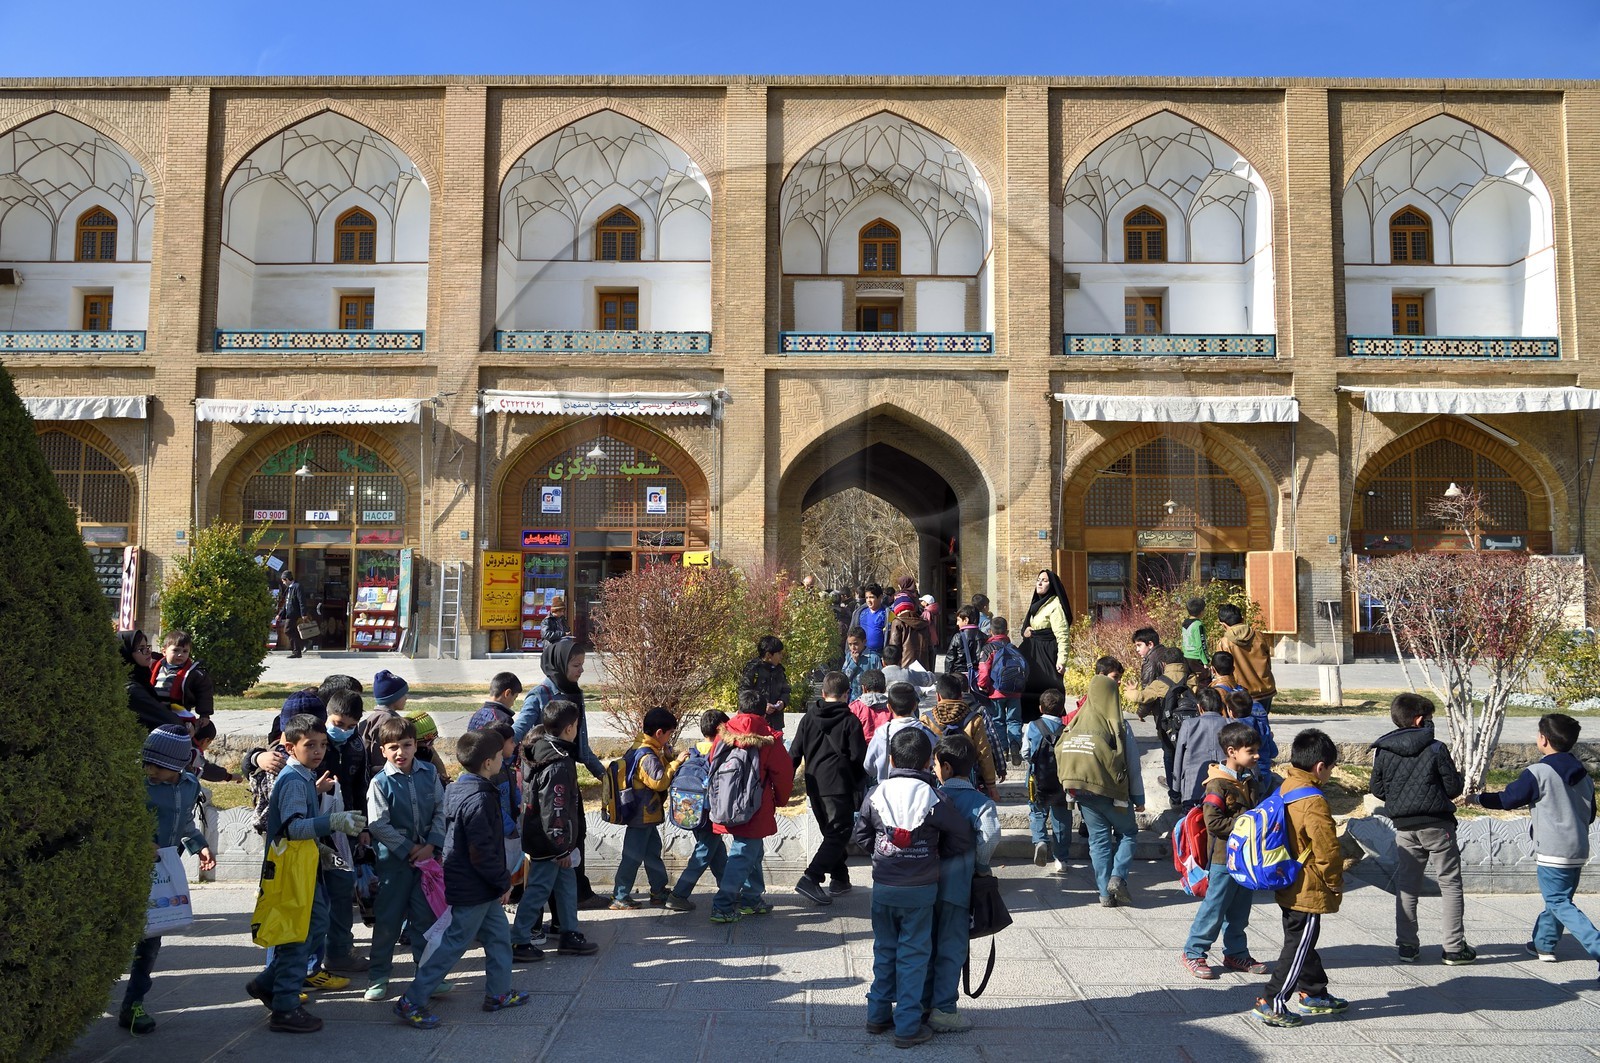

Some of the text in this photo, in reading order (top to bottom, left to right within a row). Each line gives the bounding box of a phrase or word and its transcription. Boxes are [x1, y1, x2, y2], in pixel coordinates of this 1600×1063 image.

[298, 404, 343, 416] محصولات
[343, 404, 379, 418] مستقیم
[380, 404, 408, 416] عرضه
[563, 401, 591, 410] اصفهان
[639, 402, 663, 411] رسمی
[665, 400, 699, 411] نمایندگی
[548, 452, 660, 481] شعبه مرکزی
[254, 511, 285, 520] ISO 9001
[313, 511, 330, 520] FDA
[365, 511, 394, 520] HACCP
[1485, 536, 1522, 550] نقره
[485, 554, 519, 567] دفتر فروش
[484, 572, 520, 586] گز
